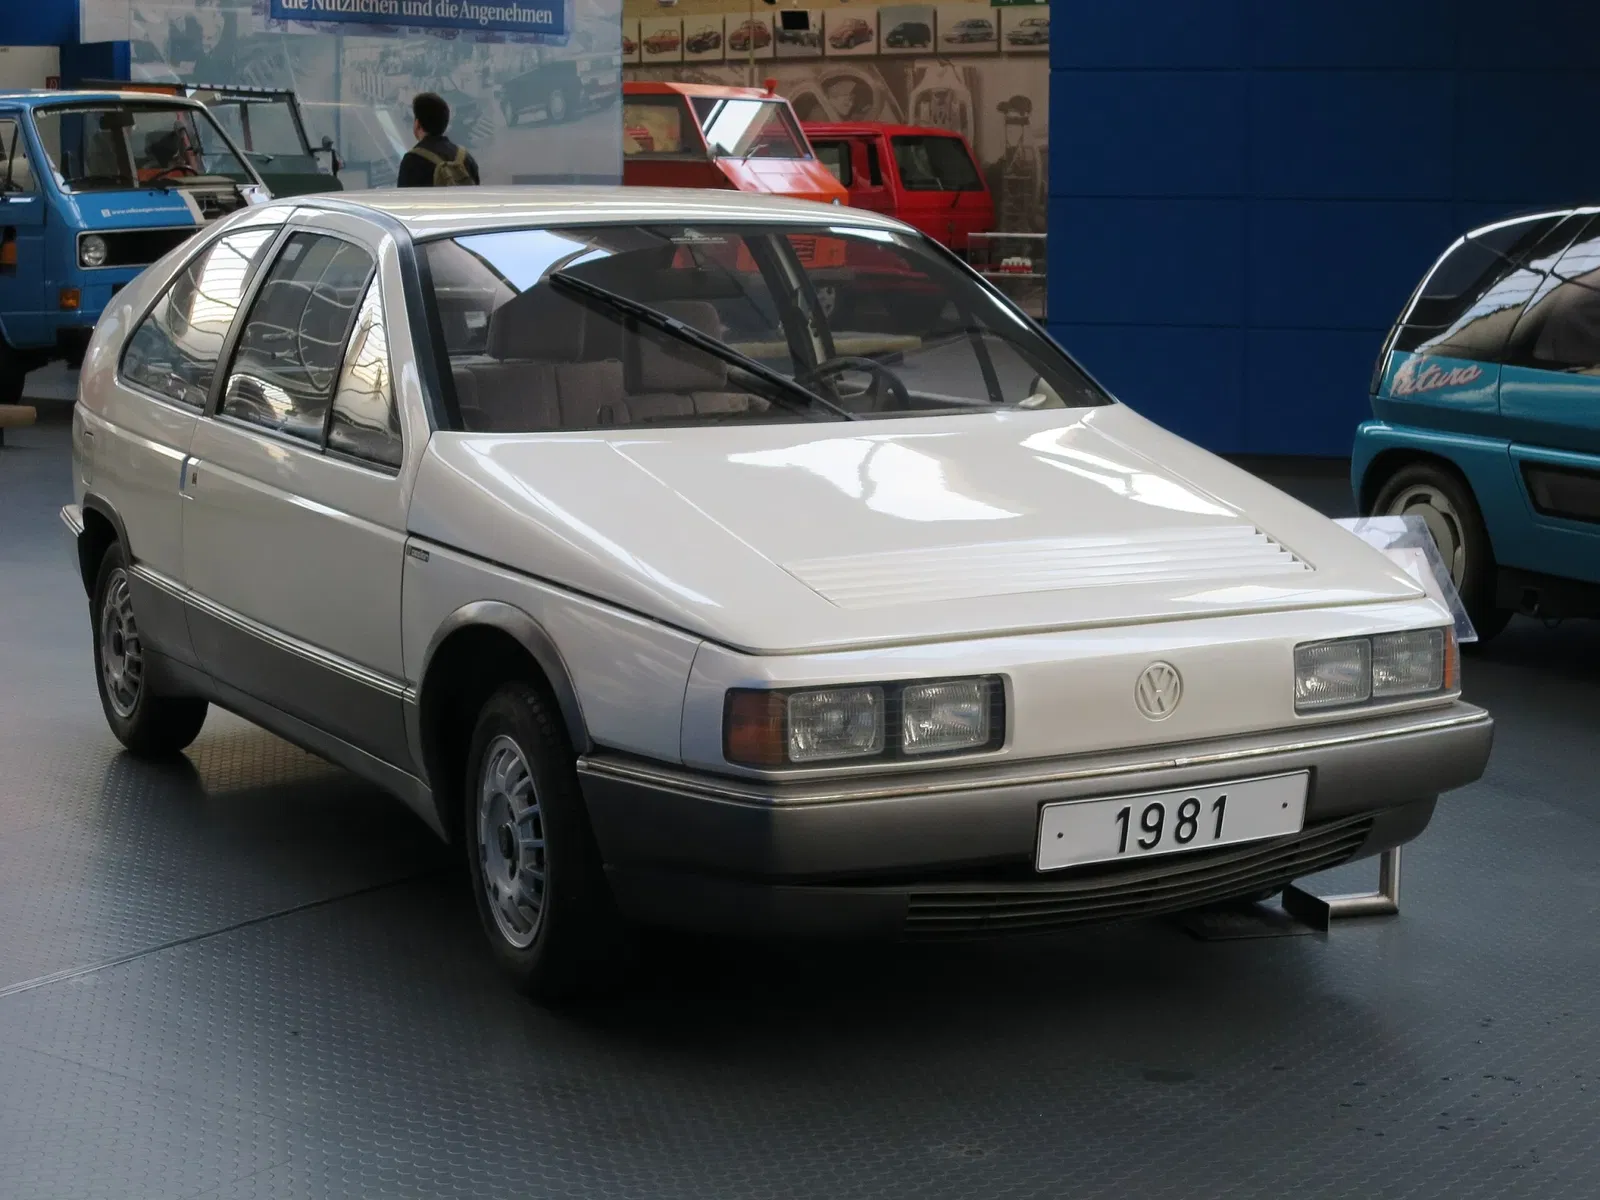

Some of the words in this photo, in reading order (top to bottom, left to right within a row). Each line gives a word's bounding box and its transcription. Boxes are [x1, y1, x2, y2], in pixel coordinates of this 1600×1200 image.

[402, 0, 432, 17] und
[435, 0, 459, 18] die
[459, 0, 553, 25] Angenehmen
[1116, 794, 1227, 853] 1981
